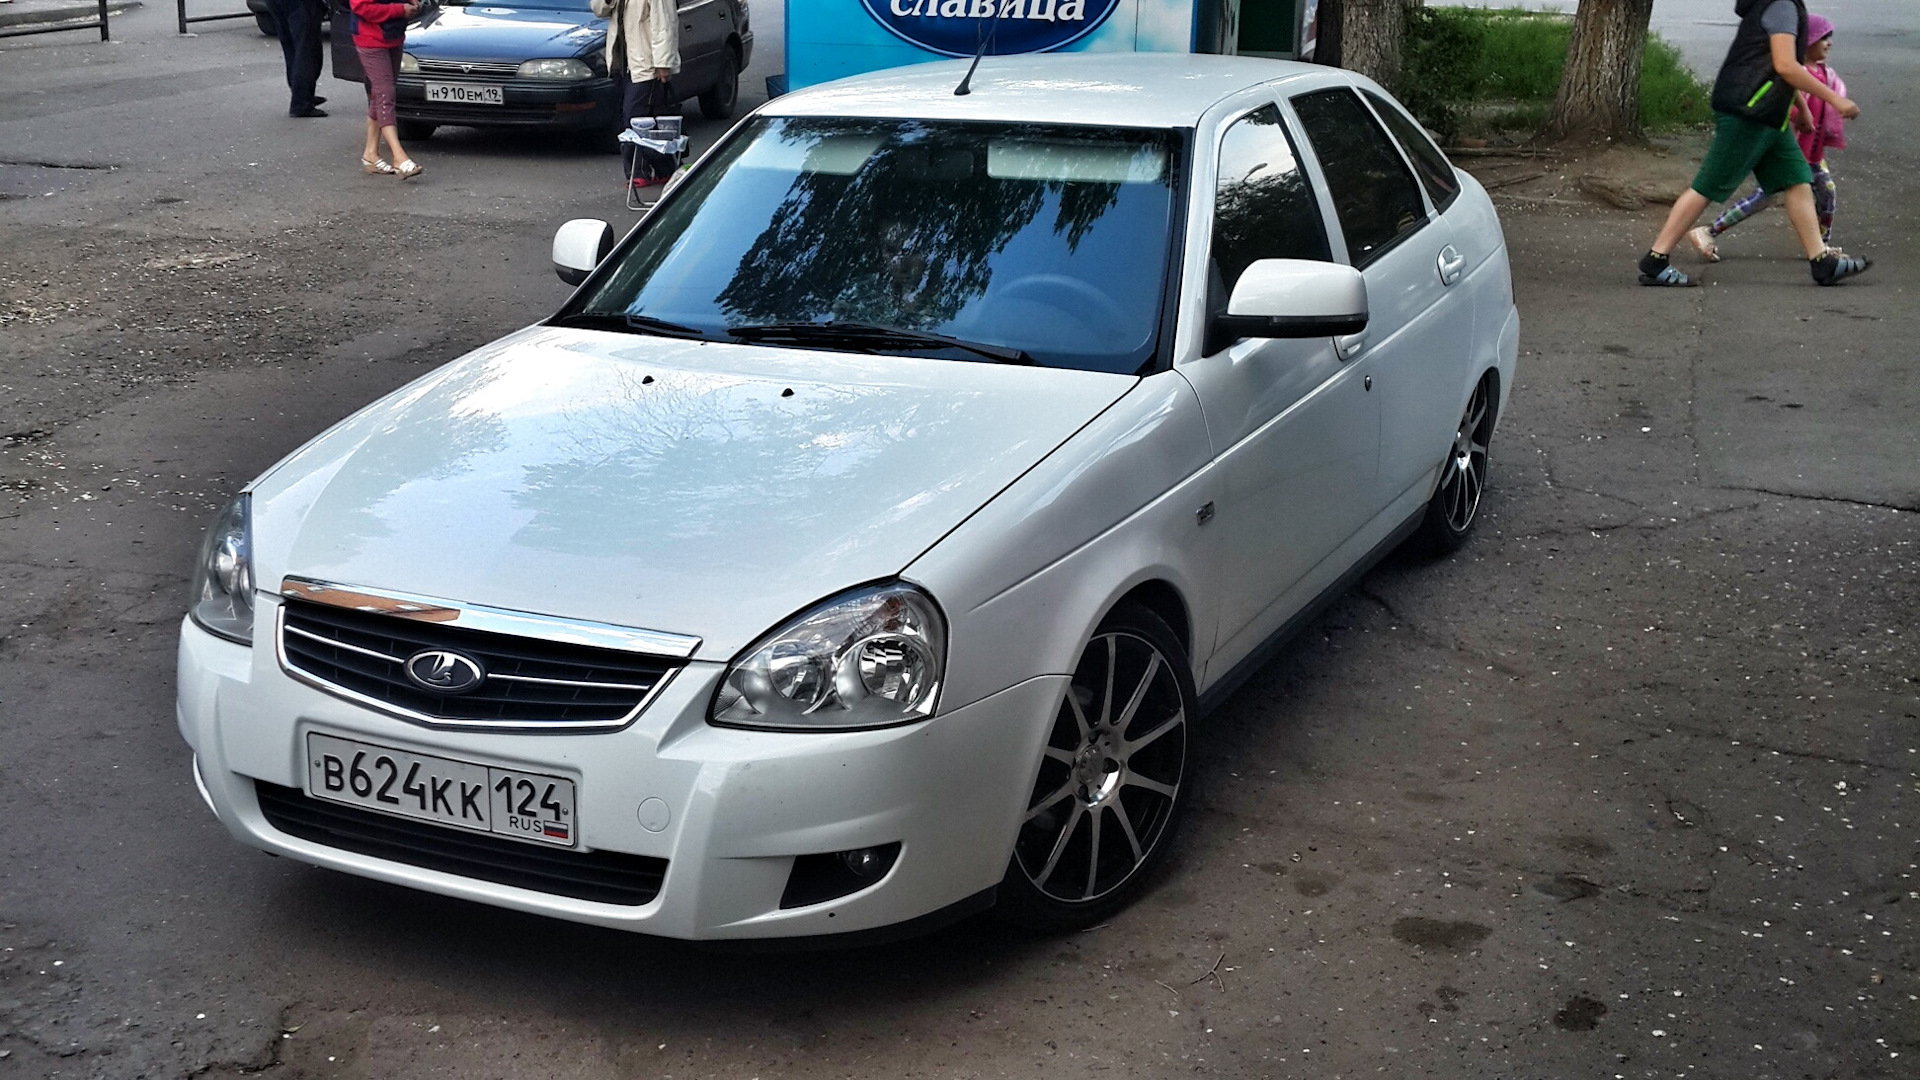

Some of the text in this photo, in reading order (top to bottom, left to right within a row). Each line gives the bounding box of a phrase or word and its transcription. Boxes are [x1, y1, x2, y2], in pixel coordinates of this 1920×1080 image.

[485, 88, 498, 99] 19
[323, 751, 561, 822] В624КК 124
[509, 816, 542, 833] RUS
